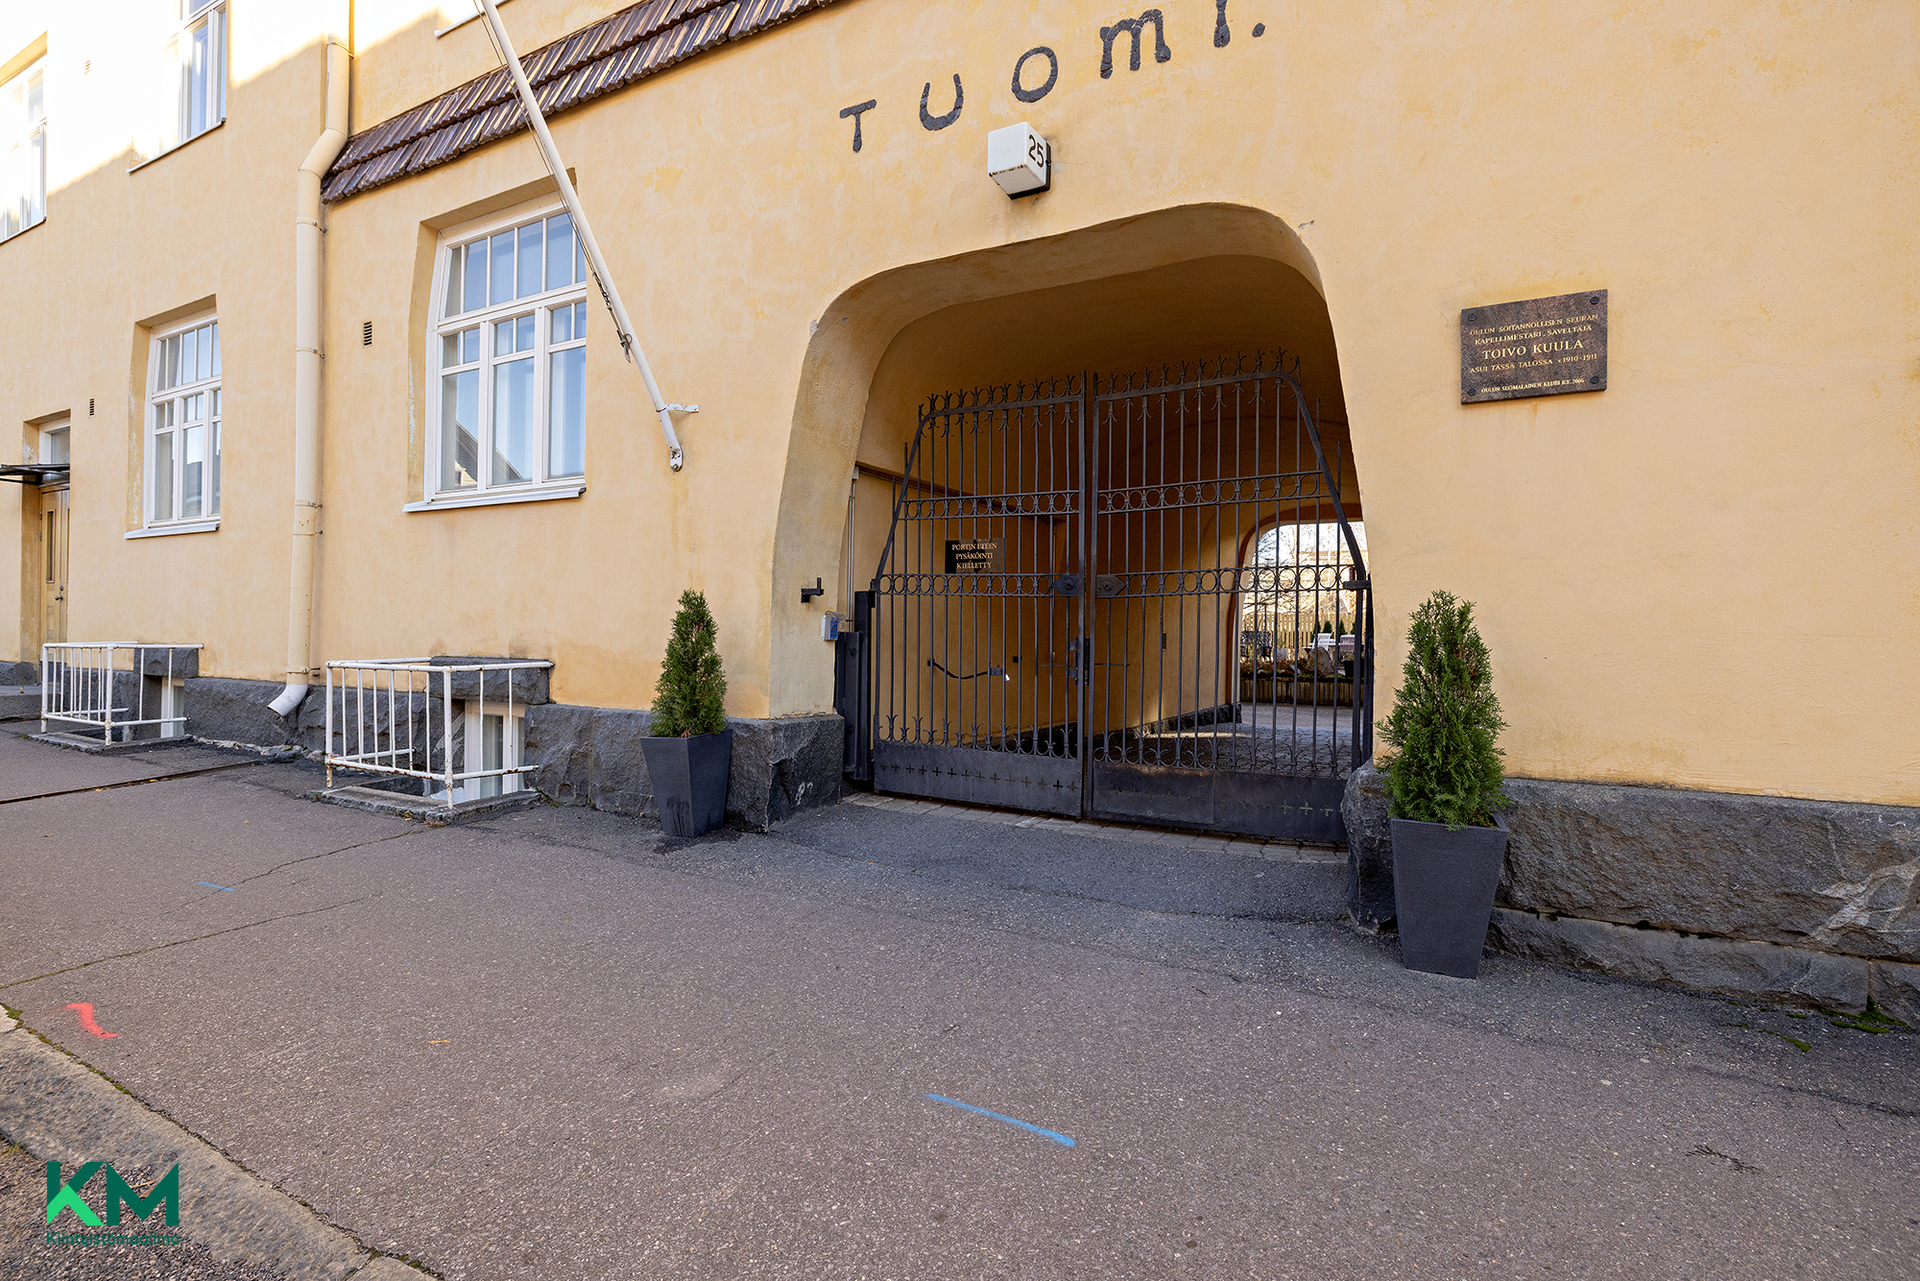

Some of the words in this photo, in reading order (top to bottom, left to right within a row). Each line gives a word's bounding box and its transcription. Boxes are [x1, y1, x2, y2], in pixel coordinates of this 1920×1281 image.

[1028, 134, 1045, 168] 25
[1470, 328, 1495, 336] OULUN
[1498, 319, 1563, 332] SOITANNOLLISEN
[1566, 314, 1598, 324] SEURAN
[1482, 346, 1527, 360] TOIVO
[1533, 340, 1583, 353] KUULA
[1519, 359, 1553, 368] TALOSSA
[1501, 383, 1542, 391] SUOMALAINEN
[956, 552, 993, 560] PYSÄKÖINTI
